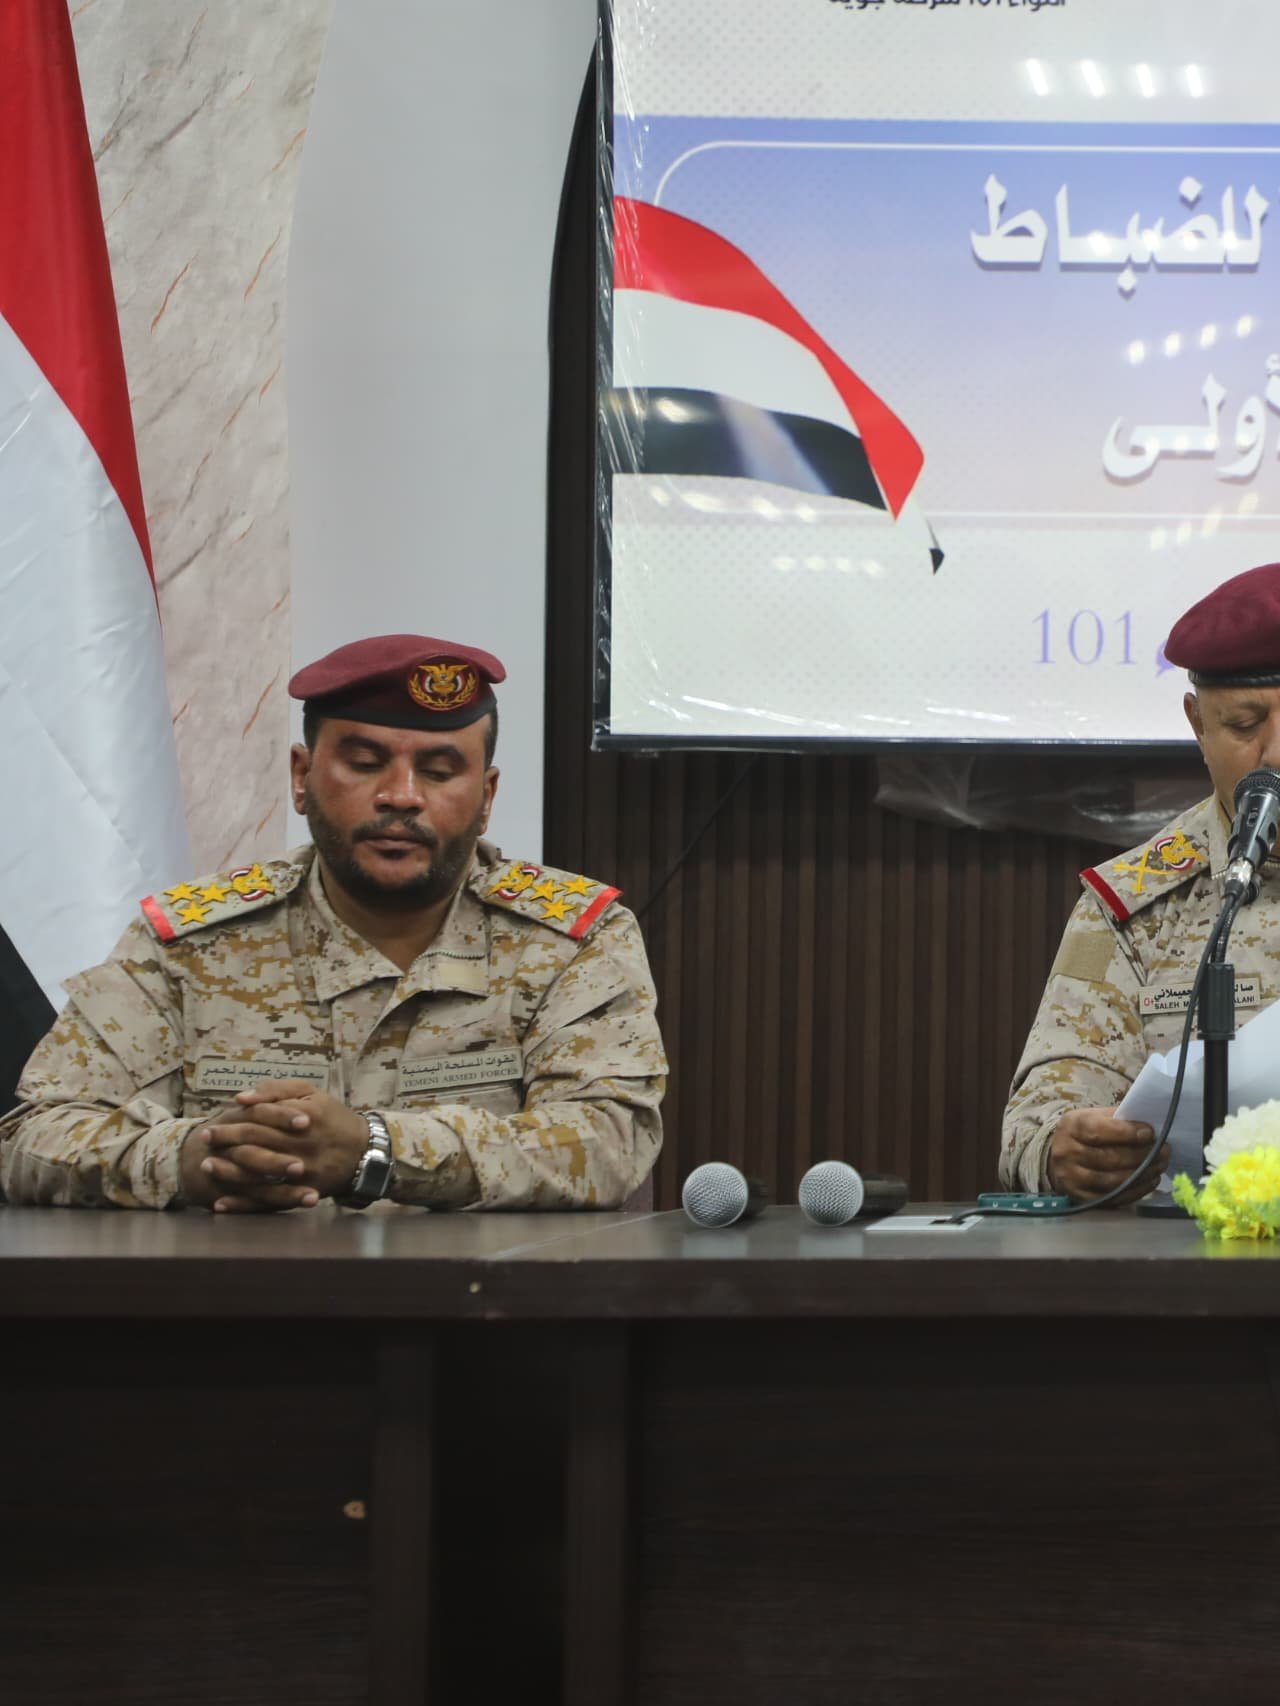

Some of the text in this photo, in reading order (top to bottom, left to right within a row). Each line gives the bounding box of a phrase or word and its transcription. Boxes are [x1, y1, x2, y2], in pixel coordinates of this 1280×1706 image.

[970, 173, 1269, 294] للضباط
[1031, 607, 1138, 666] 101
[1154, 1002, 1180, 1010] SALEH
[201, 1078, 243, 1087] SAEED
[443, 1072, 477, 1083] ARMED
[480, 1067, 519, 1079] FORCES
